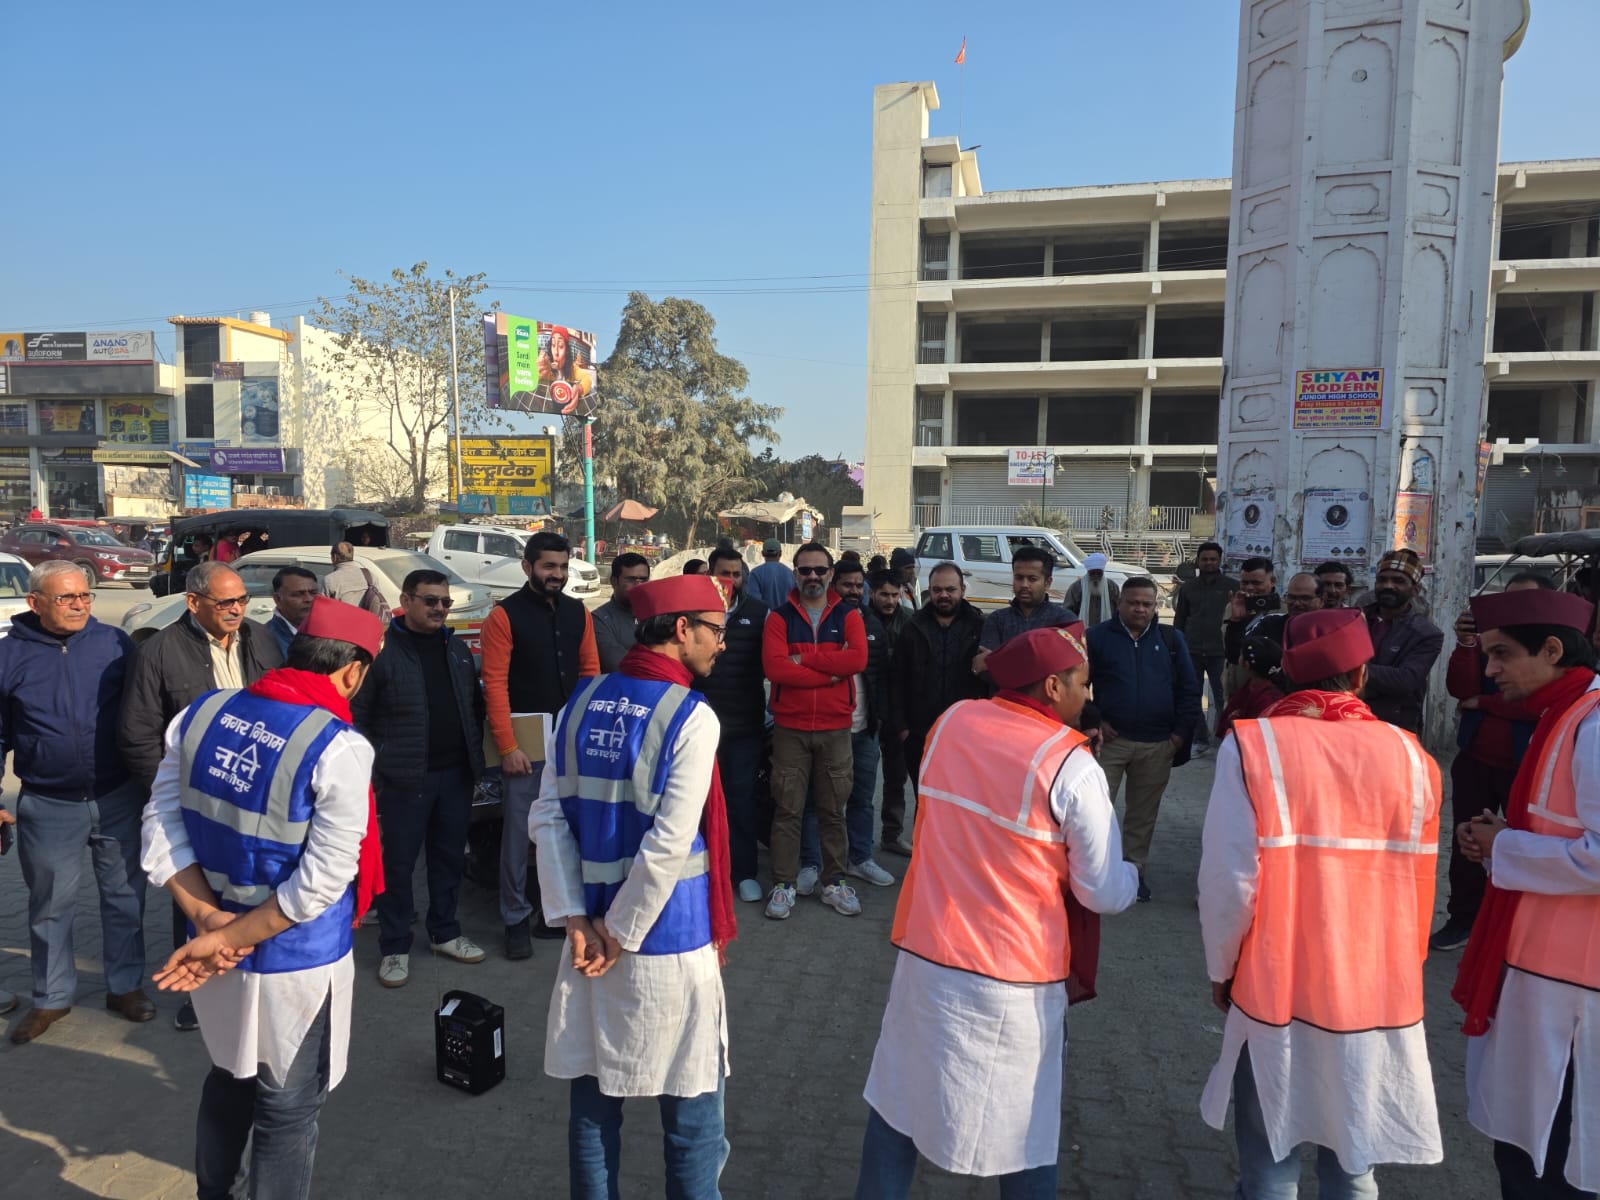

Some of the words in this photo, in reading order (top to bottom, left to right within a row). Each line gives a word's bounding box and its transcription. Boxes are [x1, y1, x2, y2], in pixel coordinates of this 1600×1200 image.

[93, 338, 128, 347] ANAND
[1301, 371, 1380, 384] SHYAM
[1301, 382, 1378, 393] MODERN
[1300, 393, 1327, 401] JUNIOR
[588, 699, 616, 713] नगर
[616, 697, 651, 719] निगम
[220, 713, 252, 736] नगर
[249, 721, 287, 752] निगम
[208, 765, 252, 792] काशीपुर
